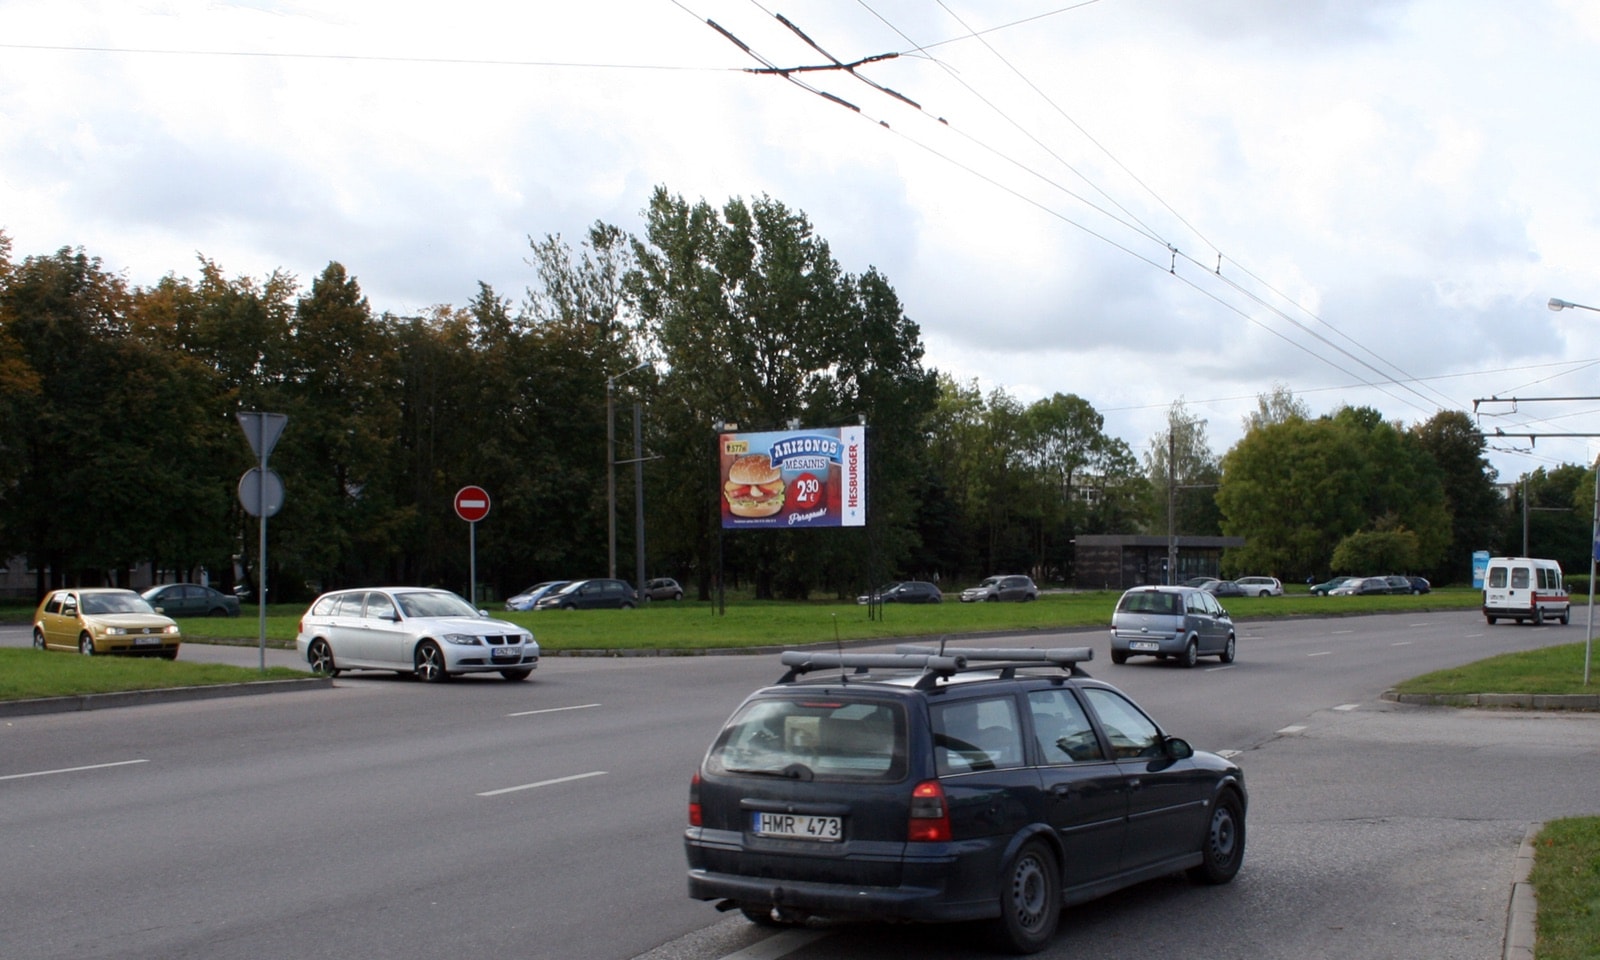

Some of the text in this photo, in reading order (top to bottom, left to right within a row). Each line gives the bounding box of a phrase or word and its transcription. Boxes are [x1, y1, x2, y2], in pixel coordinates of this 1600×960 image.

[774, 439, 837, 458] ARIZONOS
[848, 444, 858, 507] HESBURGER
[762, 815, 838, 836] HMR 473
